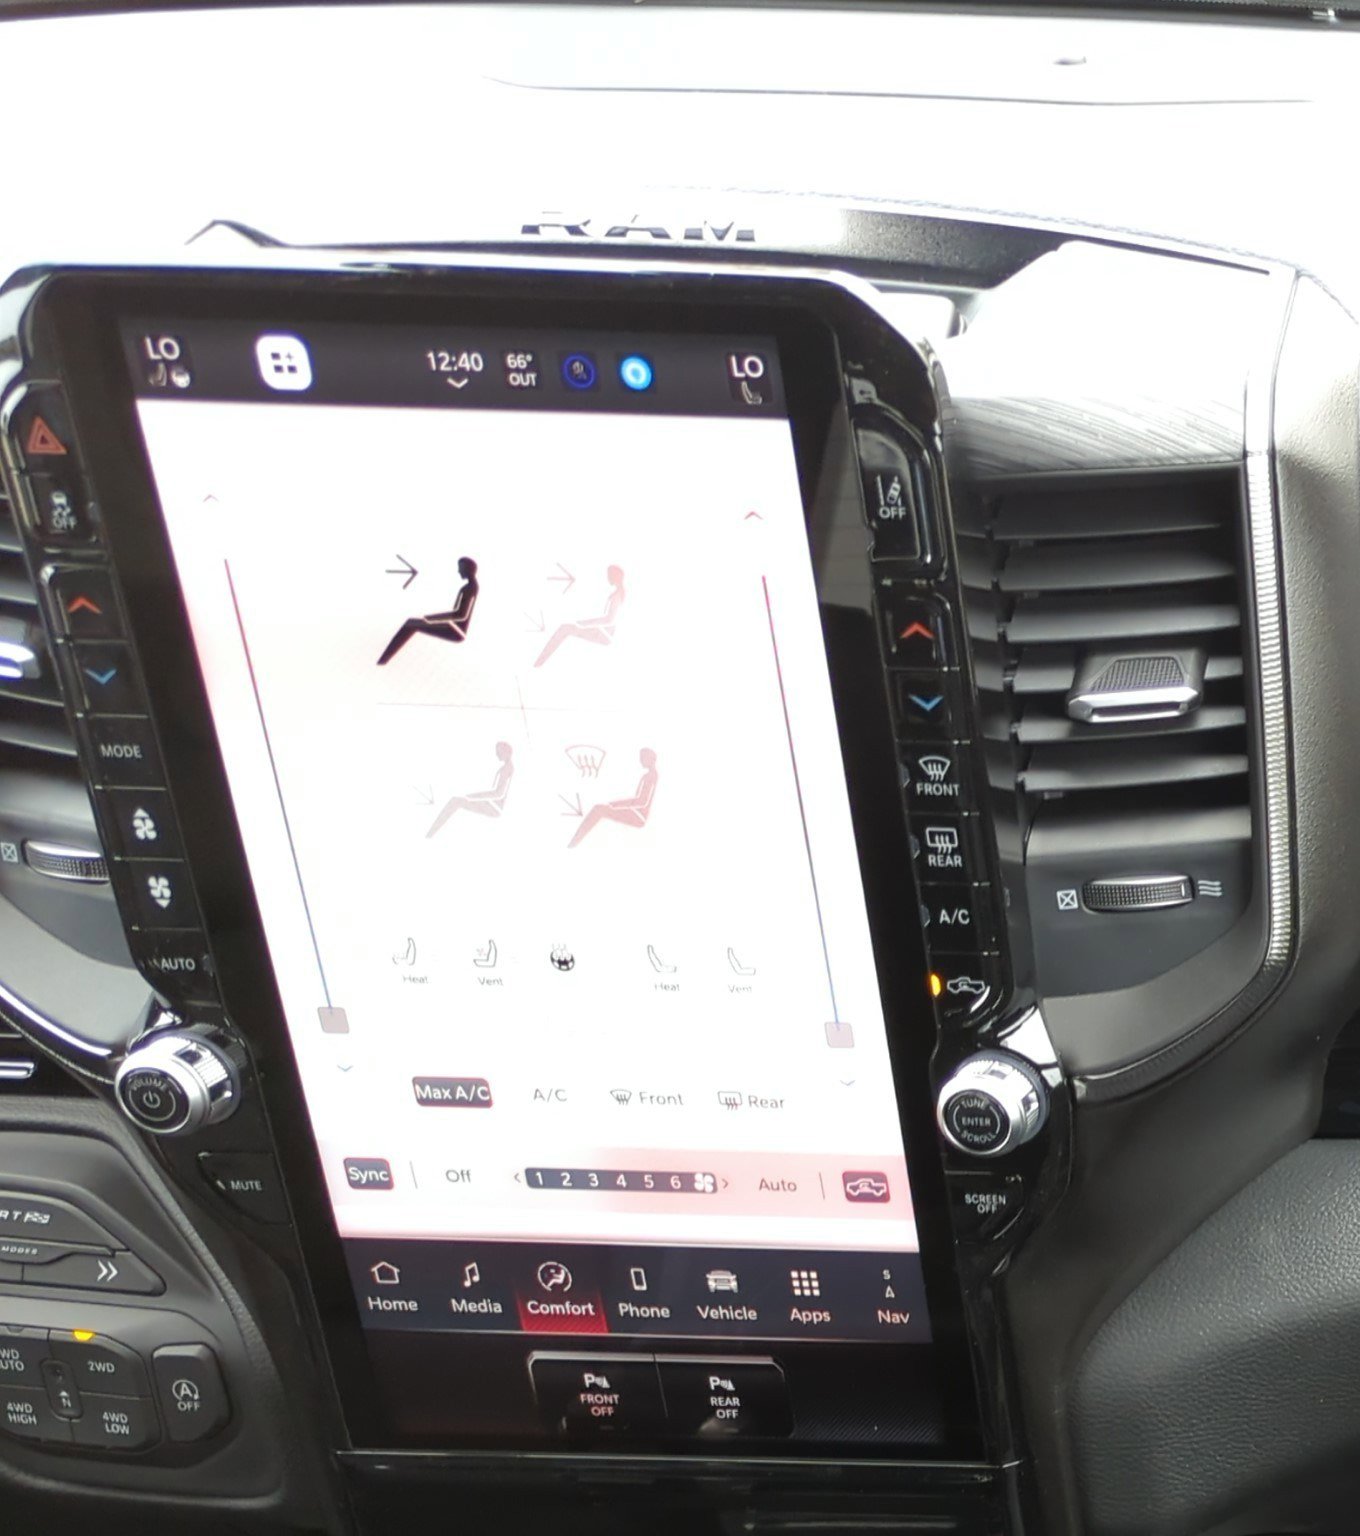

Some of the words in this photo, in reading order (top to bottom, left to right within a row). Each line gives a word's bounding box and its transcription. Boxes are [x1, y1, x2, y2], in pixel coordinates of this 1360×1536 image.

[145, 335, 181, 361] LO
[426, 351, 484, 373] 12:40
[730, 354, 764, 379] LO
[509, 373, 537, 387] OUT
[879, 507, 906, 519] OFF
[100, 744, 142, 759] MODE
[916, 783, 960, 797] FRONT
[928, 854, 963, 868] REAR
[939, 908, 970, 925] A/C
[161, 957, 196, 971] AUTO
[415, 1083, 451, 1100] Max
[455, 1085, 490, 1101] A/C
[533, 1088, 568, 1103] A/C
[639, 1091, 685, 1106] Front
[748, 1094, 785, 1110] Rear
[961, 1099, 988, 1111] TUNE
[961, 1116, 991, 1126] ENTER
[960, 1129, 996, 1144] SCROLL
[348, 1166, 390, 1185] Sync
[445, 1169, 472, 1183] Off
[560, 1172, 572, 1187] 2
[588, 1173, 600, 1187] 3
[616, 1174, 628, 1188] 4
[643, 1174, 655, 1189] 5
[670, 1175, 682, 1189] 6
[230, 1181, 262, 1191] MUTE
[758, 1177, 798, 1193] Auto
[965, 1193, 1006, 1205] SCREEN
[977, 1203, 998, 1214] OFF
[367, 1297, 418, 1312] Home
[451, 1298, 503, 1314] Media
[527, 1300, 596, 1317] Comfort
[618, 1303, 671, 1319] Phone
[697, 1304, 758, 1321] Vehicle
[789, 1307, 831, 1325] Apps
[877, 1309, 911, 1325] Nav
[0, 1348, 20, 1360] WD
[0, 1360, 25, 1372] UTO
[87, 1361, 115, 1374] 2WD
[177, 1401, 200, 1412] OFF
[580, 1393, 620, 1406] FRONT
[710, 1396, 741, 1408] REAR
[6, 1401, 33, 1415] 4WD
[590, 1406, 615, 1418] OFF
[716, 1408, 739, 1420] OFF
[8, 1413, 37, 1426] HIGH
[102, 1411, 128, 1424] 4WD
[105, 1423, 130, 1435] LOW
